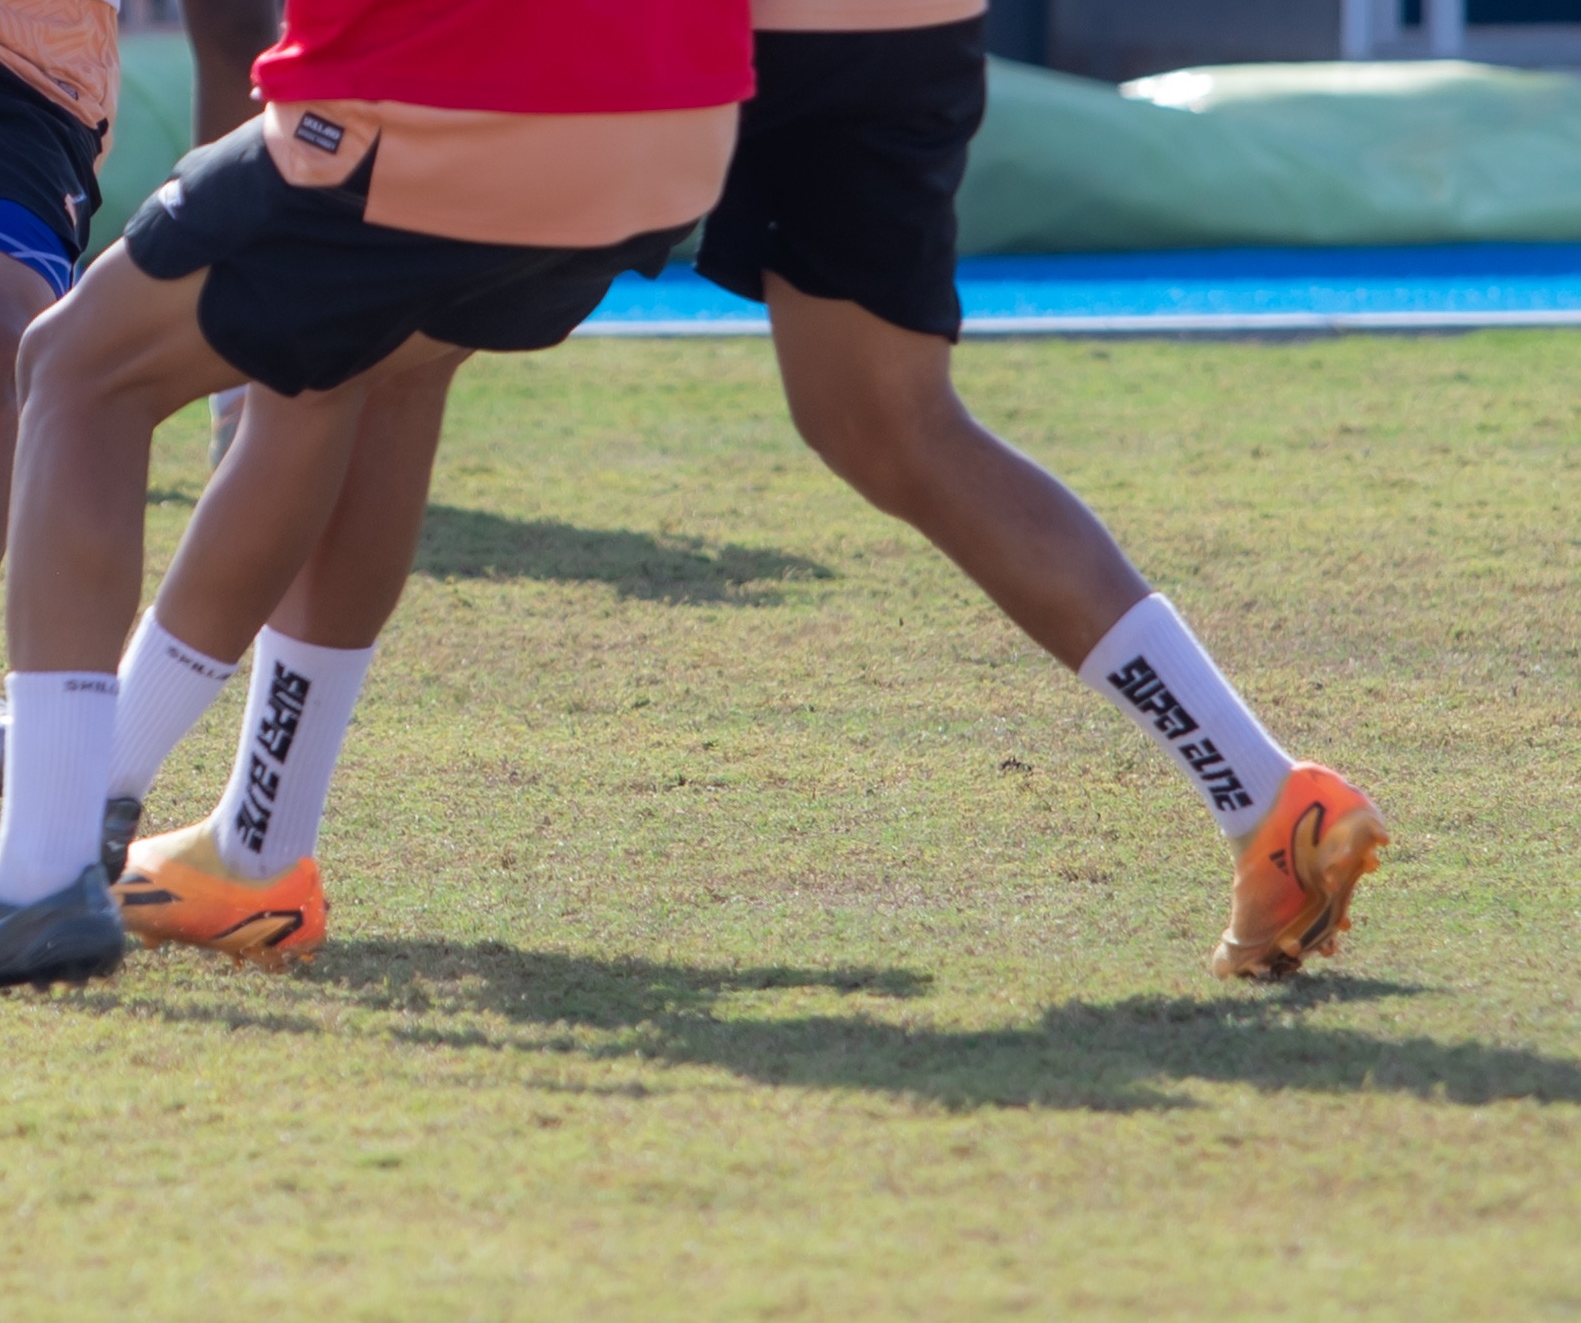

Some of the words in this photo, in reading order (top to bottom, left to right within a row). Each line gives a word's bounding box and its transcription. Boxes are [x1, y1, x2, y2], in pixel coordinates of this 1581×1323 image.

[257, 659, 312, 765] SUPER
[1105, 654, 1200, 741] SUPER
[1177, 737, 1255, 812] ELITE
